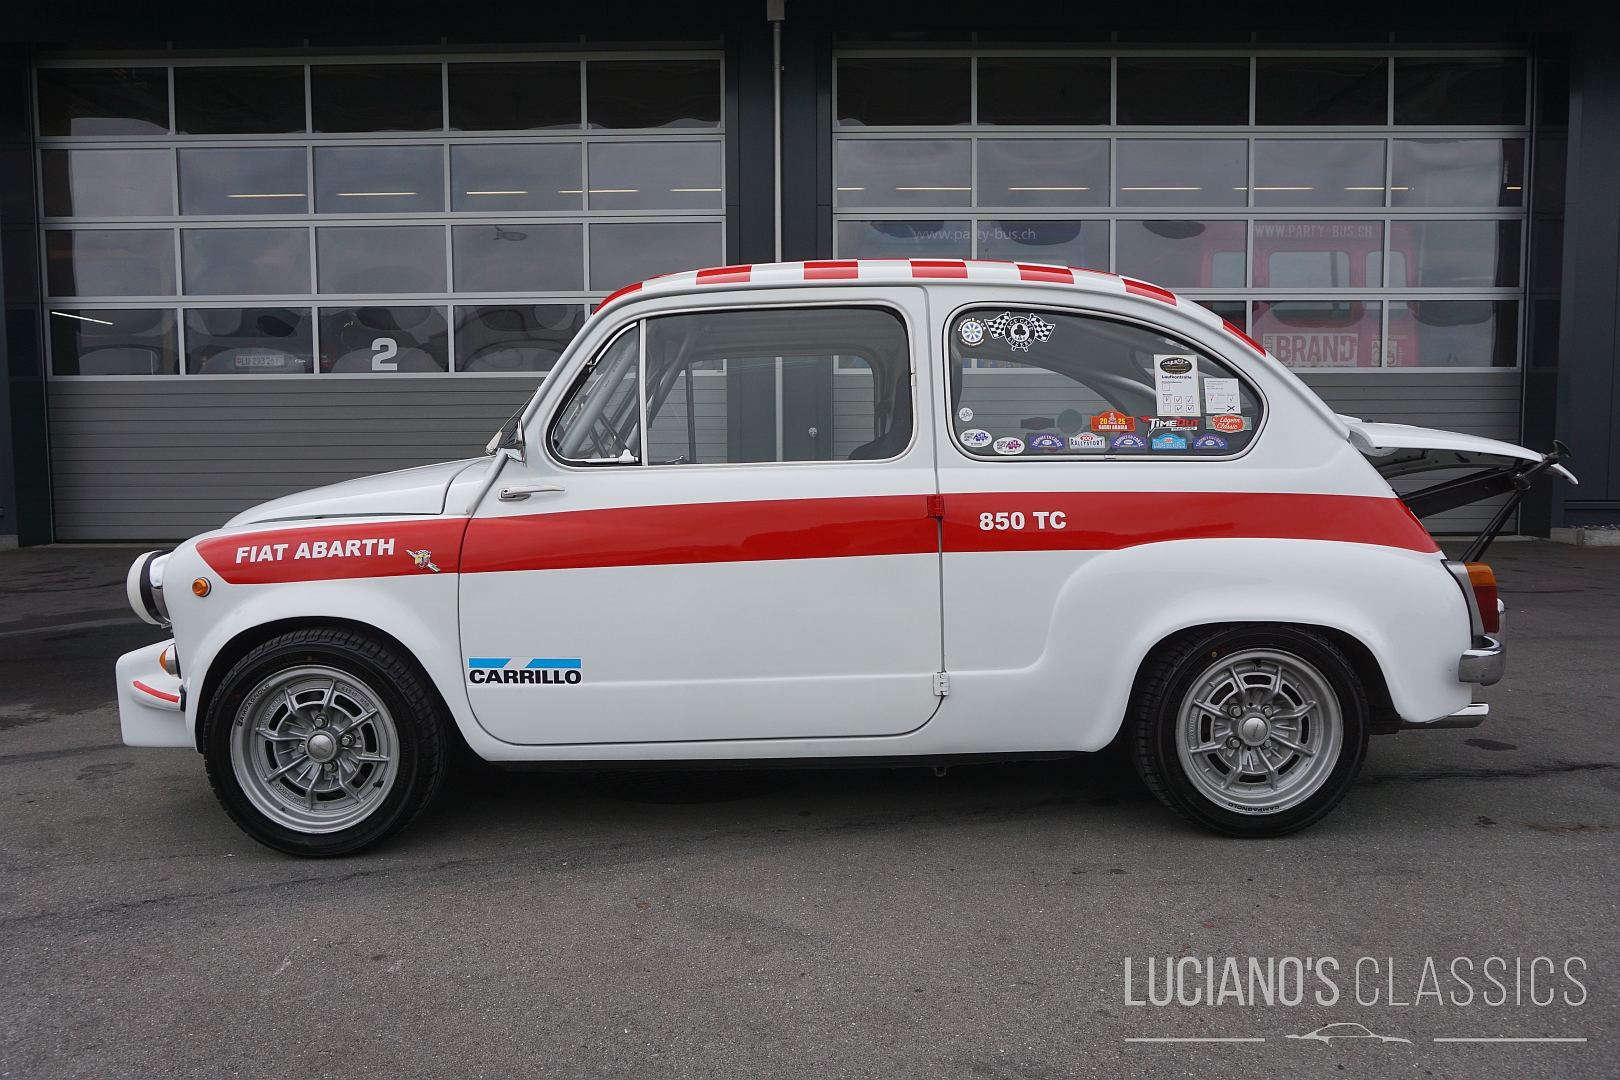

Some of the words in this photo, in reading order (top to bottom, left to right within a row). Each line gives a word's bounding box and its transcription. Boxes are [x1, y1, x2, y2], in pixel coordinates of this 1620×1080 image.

[914, 228, 1036, 242] www.paty-bus.ch
[371, 337, 398, 371] 2
[1276, 335, 1355, 362] BRAND
[1100, 417, 1108, 425] 20
[1118, 417, 1126, 425] 25
[979, 511, 1025, 531] 850
[1032, 510, 1067, 530] TC
[235, 543, 289, 564] FIAT
[294, 538, 395, 560] ABARTH
[469, 669, 582, 685] CARRILLO
[1227, 802, 1280, 812] CAMPAGNOLO
